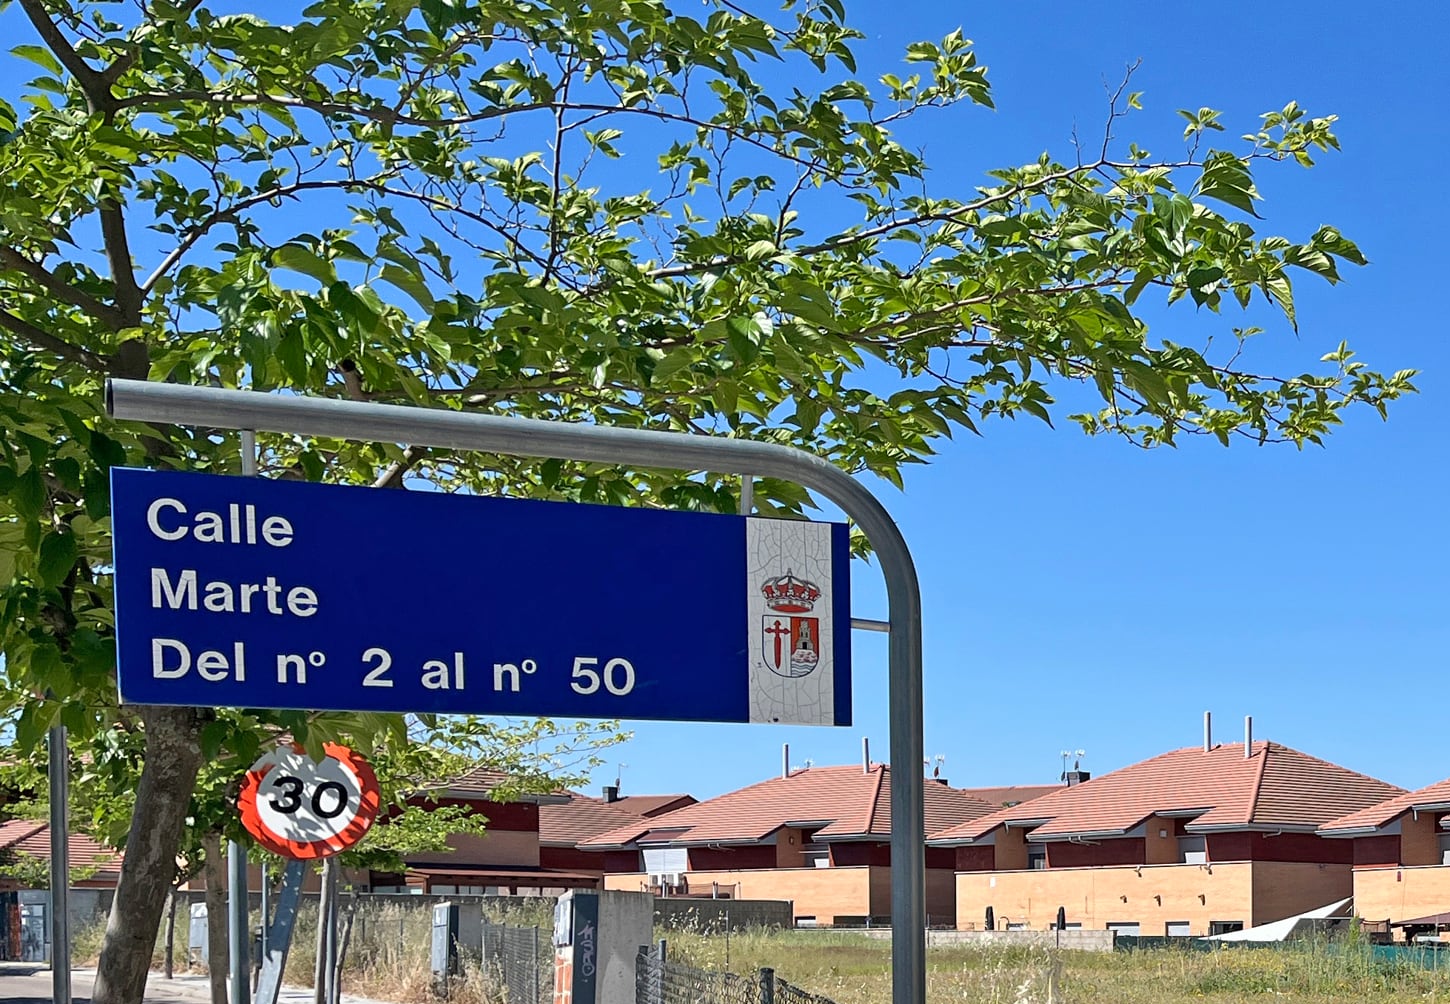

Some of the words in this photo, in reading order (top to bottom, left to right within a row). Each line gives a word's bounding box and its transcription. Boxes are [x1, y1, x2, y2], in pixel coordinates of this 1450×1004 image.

[147, 497, 294, 547] Calle
[151, 567, 318, 617] Marte
[151, 638, 245, 682] Del
[362, 647, 394, 687] 2
[421, 652, 464, 690] al
[570, 656, 635, 696] 50
[270, 775, 349, 819] 30
